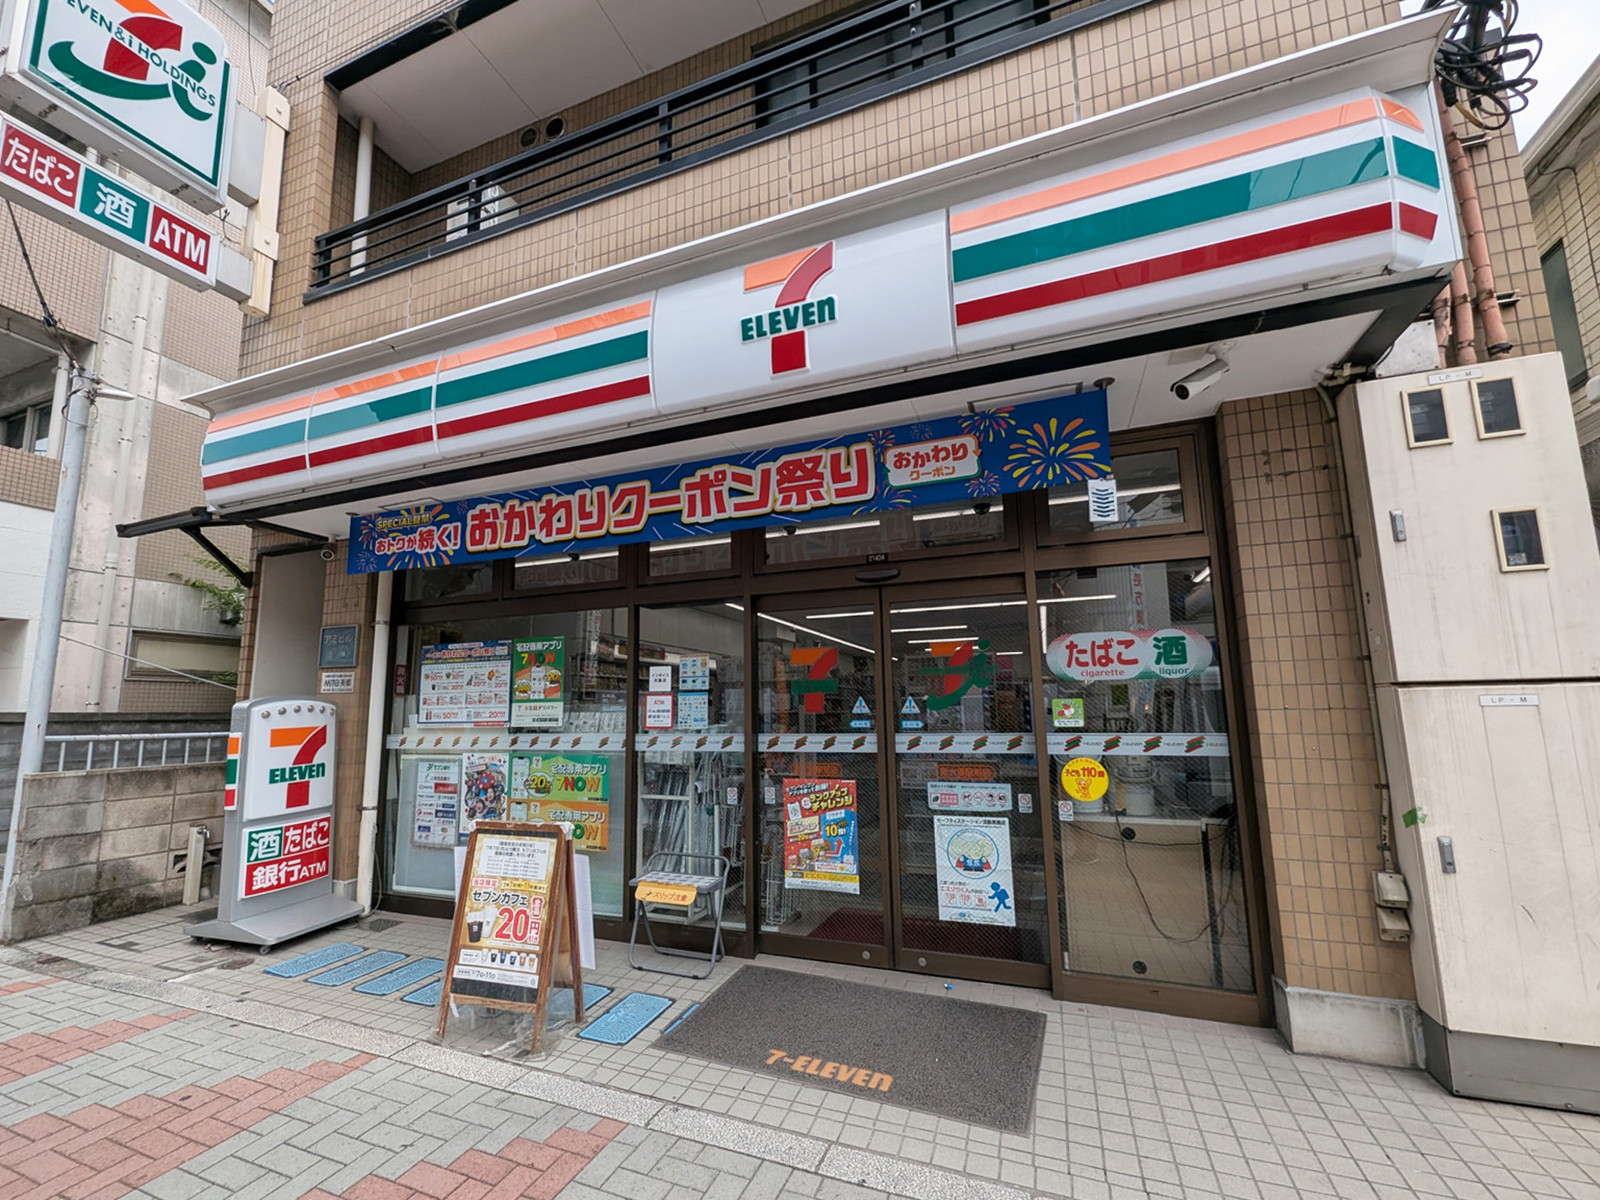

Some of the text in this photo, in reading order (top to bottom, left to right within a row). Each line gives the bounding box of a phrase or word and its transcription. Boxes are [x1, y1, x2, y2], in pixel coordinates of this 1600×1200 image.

[138, 43, 215, 107] HOLDINGS
[4, 138, 207, 267] たばこ 酒 ATM
[893, 441, 968, 469] おかわり
[909, 464, 956, 480] クーポン
[470, 446, 870, 547] おかわりクーポン祭り
[376, 525, 459, 553] おトクが続く!
[1065, 635, 1187, 669] たばこ 酒
[1080, 665, 1190, 677] cigarette liquor
[551, 763, 607, 775] 宅配専用アプリ
[556, 776, 600, 791] 7NOW
[809, 787, 848, 802] ランクアップ
[812, 795, 852, 811] チャレンジ
[548, 810, 606, 823] 宅配専用アプリ
[250, 821, 329, 860] 酒 たばこ
[252, 859, 327, 890] 銀行ATM
[473, 891, 528, 906] セブンカフェ
[653, 892, 688, 902] スリップ注意
[495, 908, 529, 941] 20
